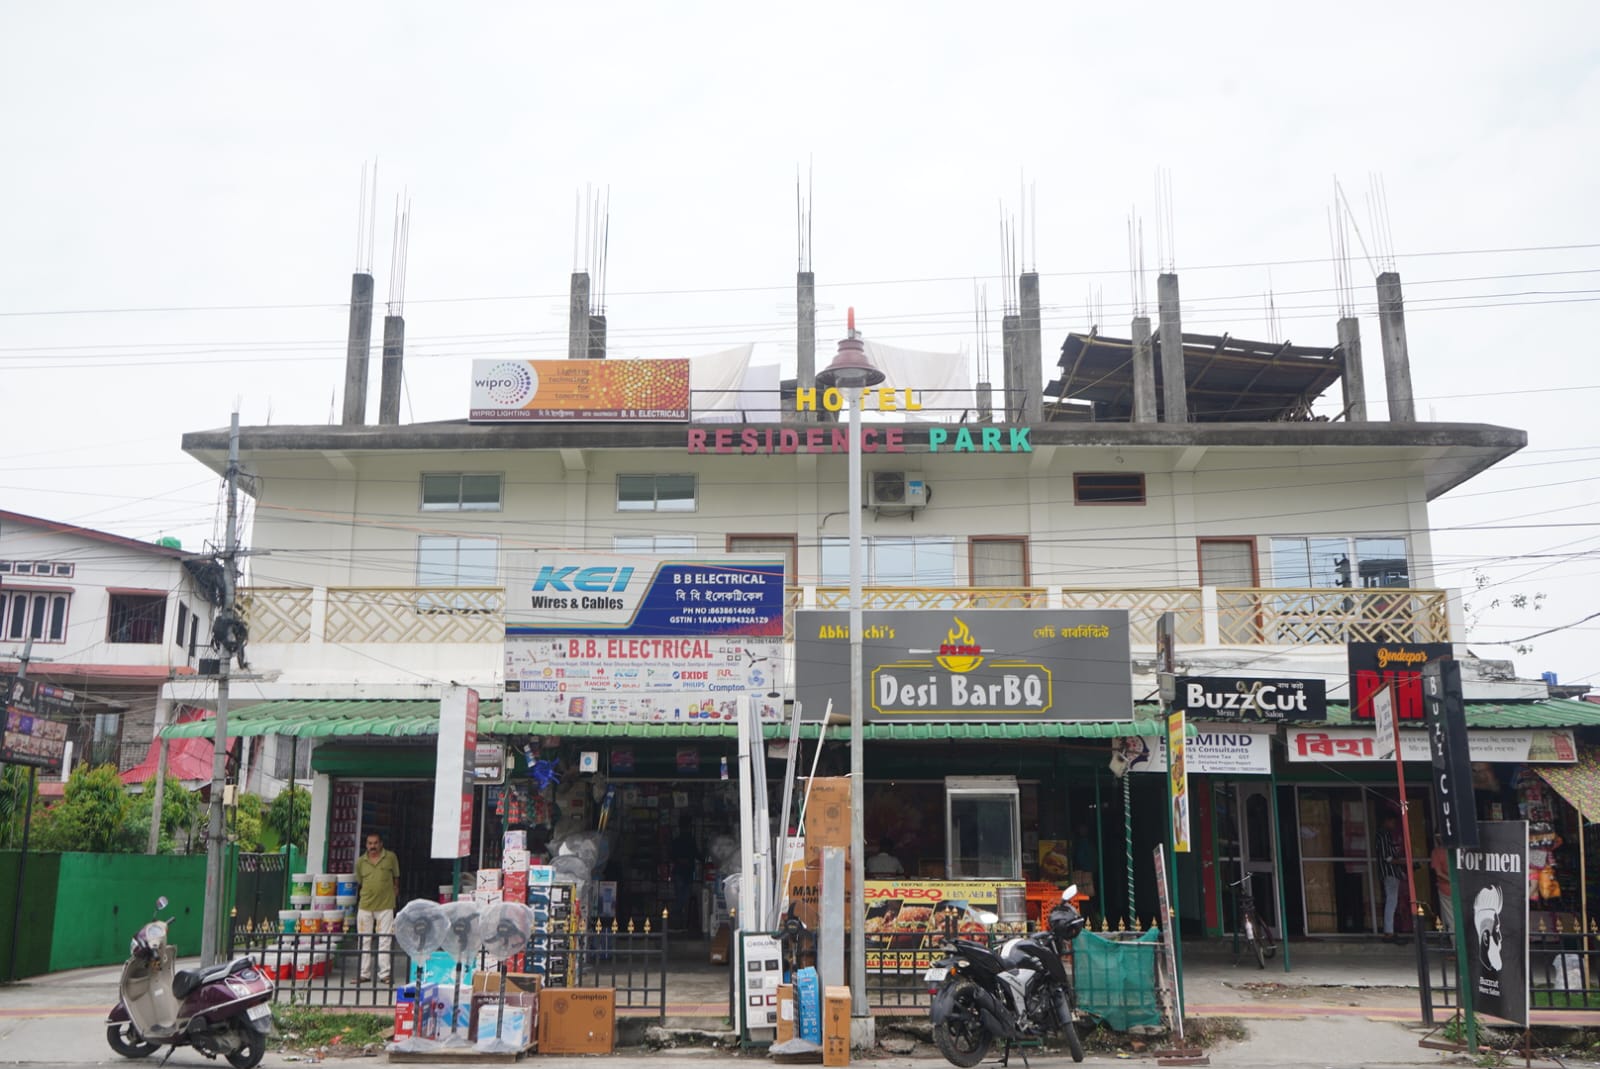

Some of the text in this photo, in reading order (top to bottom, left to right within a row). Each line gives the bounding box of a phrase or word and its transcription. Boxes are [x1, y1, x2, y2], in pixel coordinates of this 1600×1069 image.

[475, 378, 512, 390] wipro
[638, 410, 685, 418] ELECTRICALS
[687, 427, 1032, 454] RESIDENCE PARK
[532, 566, 635, 592] KEI
[673, 574, 766, 584] B B ELECTRICAL
[532, 596, 624, 609] Wires & Cables
[607, 639, 713, 659] ELECTRICAL
[681, 671, 709, 680] EXIDE
[708, 683, 745, 692] Crompton
[879, 674, 1042, 707] Desi BarBQ
[1198, 746, 1249, 754] Consultants
[1456, 848, 1521, 873] For men
[571, 993, 608, 1001] Crompton
